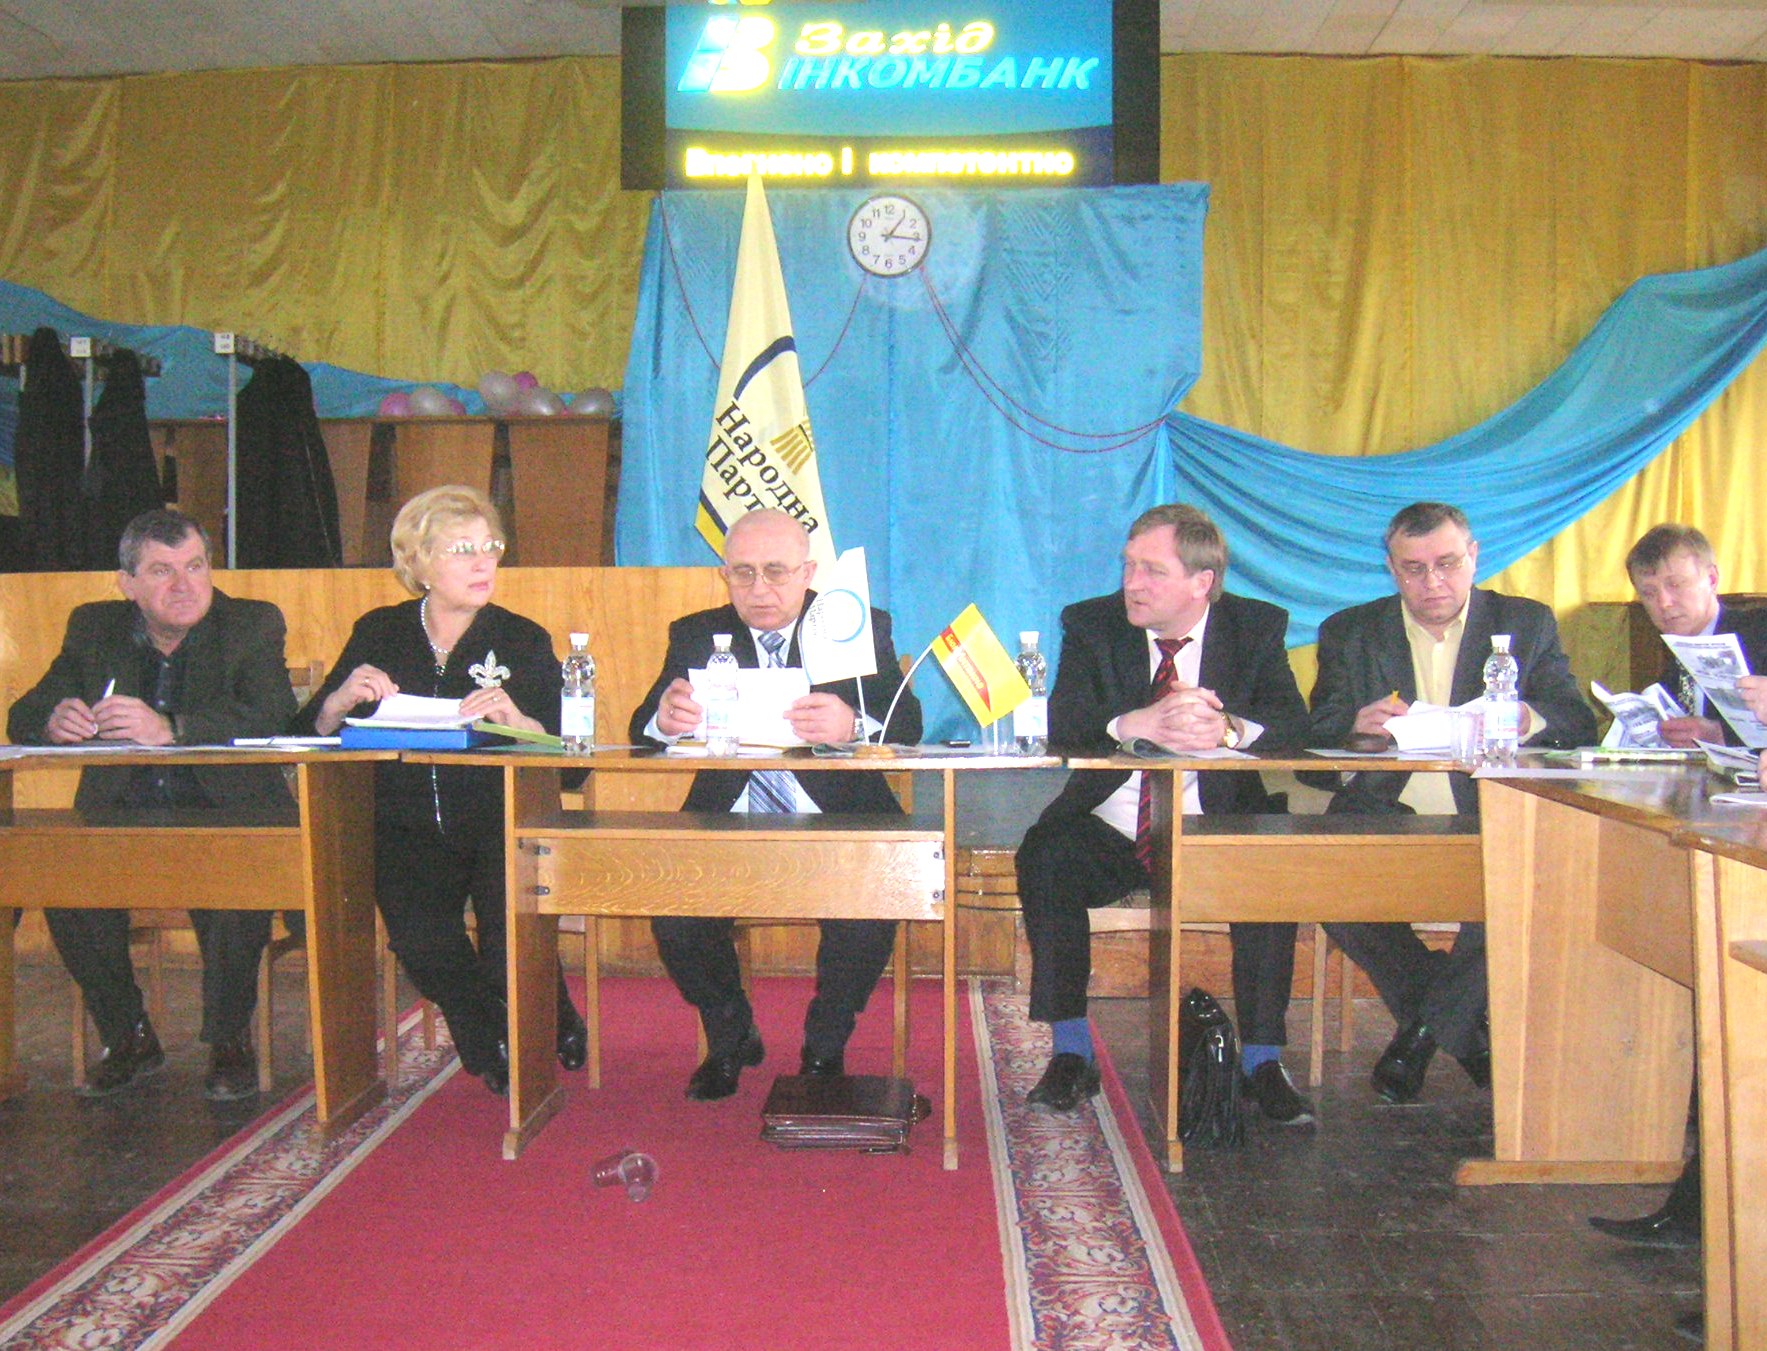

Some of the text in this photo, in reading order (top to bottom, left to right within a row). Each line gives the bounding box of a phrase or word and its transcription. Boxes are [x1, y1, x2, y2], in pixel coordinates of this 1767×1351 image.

[796, 20, 995, 55] Захід
[778, 56, 1098, 91] ІНКОМБАНК
[884, 204, 895, 215] 12
[861, 218, 872, 229] 10
[910, 218, 917, 229] 2
[858, 231, 866, 242] 9
[862, 245, 869, 256] 8
[908, 245, 915, 256] 4
[873, 254, 880, 265] 7
[884, 258, 893, 269] 6
[898, 254, 906, 266] 5
[715, 400, 819, 534] Народна
[706, 435, 777, 513] Парт
